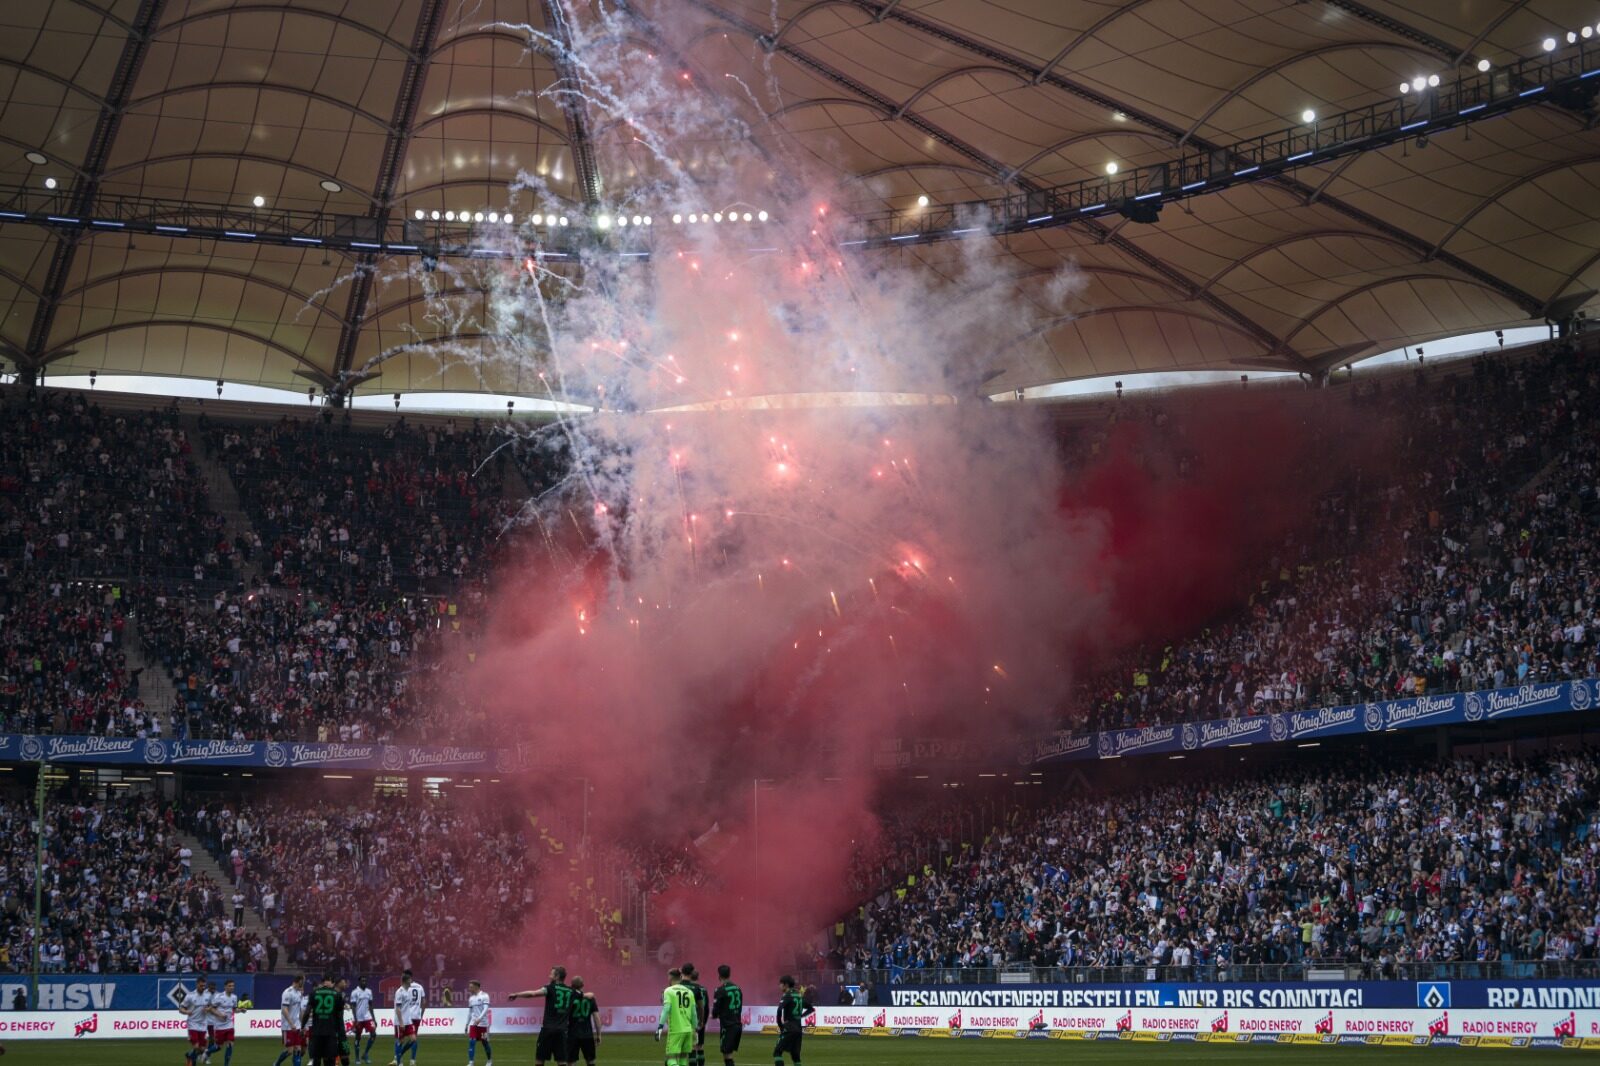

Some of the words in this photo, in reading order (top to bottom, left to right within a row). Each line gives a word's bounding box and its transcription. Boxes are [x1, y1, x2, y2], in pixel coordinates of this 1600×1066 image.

[1487, 691, 1519, 712] König
[1519, 685, 1560, 704] Pilsener
[1386, 703, 1417, 722] König
[1416, 697, 1455, 715] Pilsener
[1290, 714, 1319, 733] König
[1319, 707, 1355, 725] Pilsener
[1116, 733, 1142, 750] König
[1141, 727, 1174, 744] Pilsener
[1201, 723, 1228, 742] König
[1227, 718, 1262, 735] Pilsener
[48, 738, 87, 755] König
[86, 736, 132, 752] Pilsener
[291, 744, 328, 761] König
[327, 743, 372, 759] Pilsener
[38, 983, 116, 1010] HSV
[412, 988, 419, 1001] 9
[555, 990, 571, 1008] 31
[676, 991, 690, 1008] 16
[728, 991, 741, 1009] 23
[1062, 990, 1160, 1006] BESTELLEN
[1178, 989, 1218, 1007] NUR
[1223, 989, 1254, 1007] BIS
[315, 994, 335, 1014] 29
[573, 999, 591, 1018] 20
[11, 1022, 55, 1031] ENERGY
[114, 1021, 149, 1030] RADIO
[506, 1016, 538, 1025] RADIO
[626, 1015, 657, 1024] RADIO
[824, 1015, 842, 1025] RADIO
[843, 1016, 865, 1025] ENERGY
[894, 1016, 913, 1025] RADIO
[915, 1016, 939, 1026] ENERGY
[970, 1017, 992, 1026] RADIO
[995, 1017, 1019, 1027] ENERGY
[1053, 1018, 1076, 1028] RADIO
[1077, 1018, 1106, 1028] ENERGY
[1143, 1018, 1167, 1029] RADIO
[1168, 1018, 1200, 1029] ENERGY
[1240, 1019, 1267, 1030] RADIO
[1269, 1020, 1302, 1031] ENERGY
[1346, 1020, 1375, 1032] RADIO
[1377, 1020, 1414, 1032] ENERGY
[1463, 1021, 1494, 1033] RADIO
[1497, 1021, 1538, 1033] ENERGY
